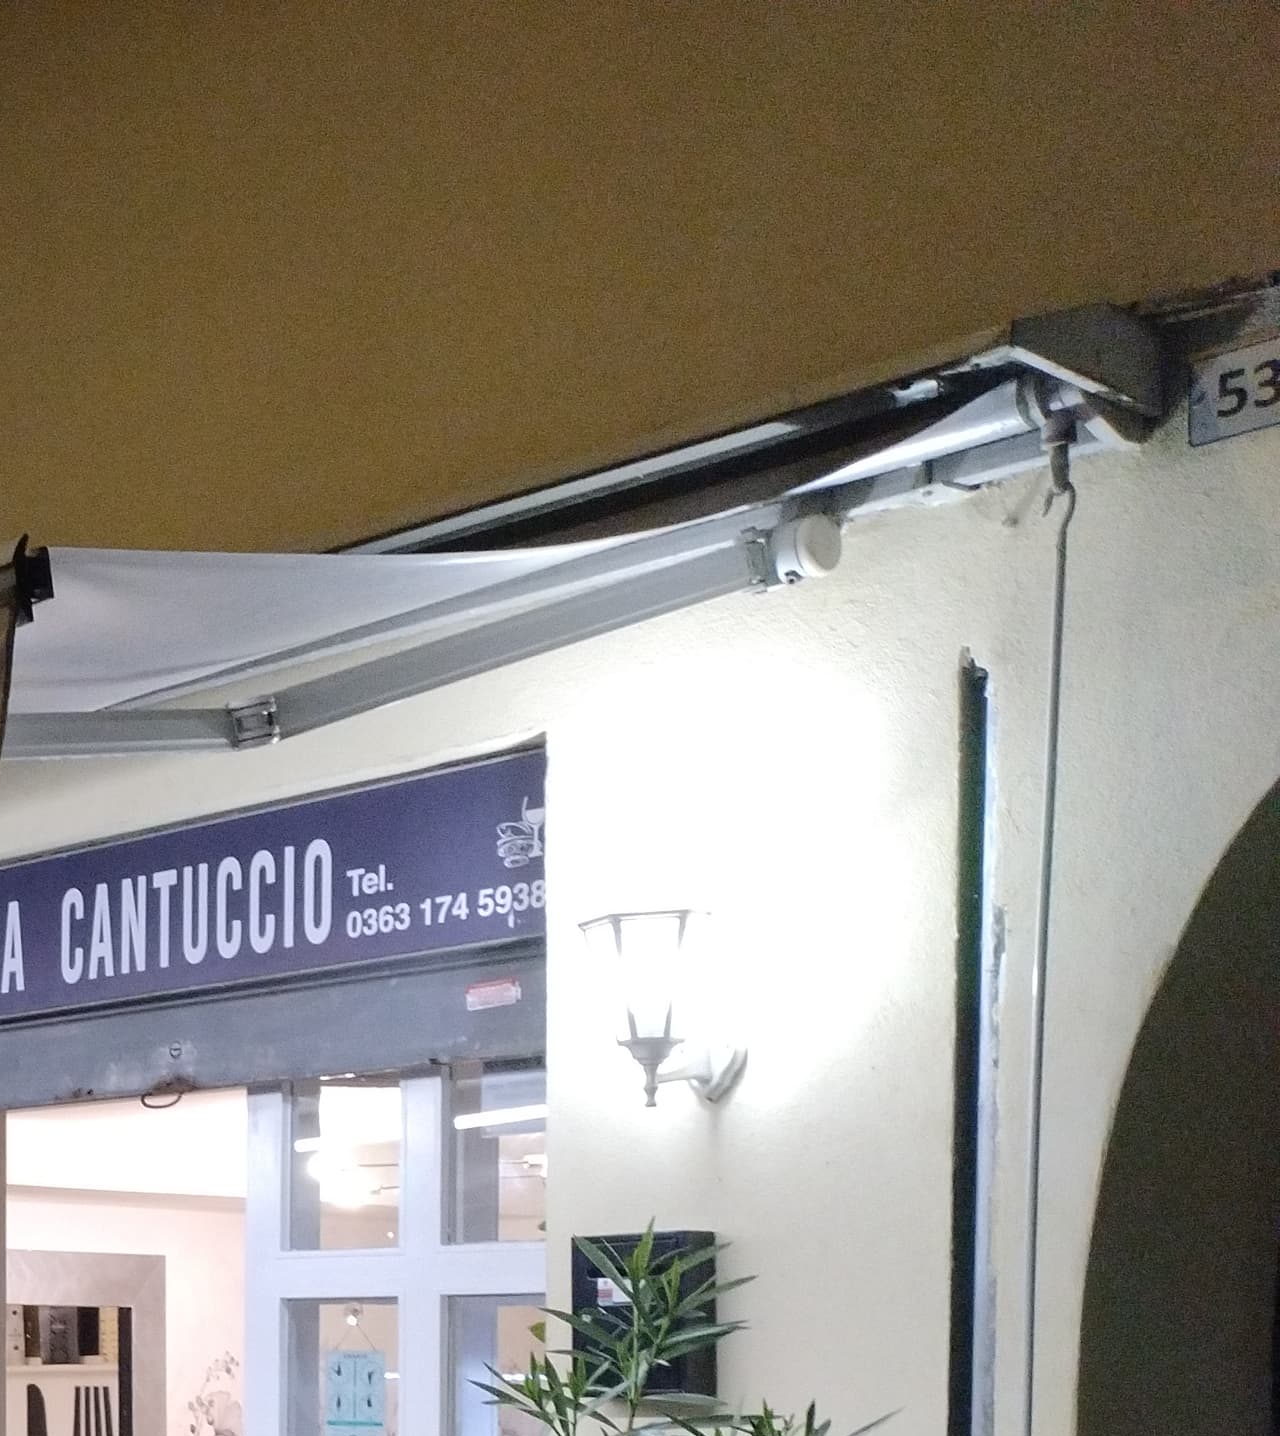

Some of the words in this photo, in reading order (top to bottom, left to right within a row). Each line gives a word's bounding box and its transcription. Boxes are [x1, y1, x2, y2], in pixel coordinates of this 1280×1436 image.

[1217, 359, 1280, 417] 53
[346, 864, 394, 897] Tel.
[346, 902, 411, 938] 0363
[420, 892, 470, 926] 174
[477, 879, 545, 917] 5938
[60, 837, 333, 986] CANTUCCIO
